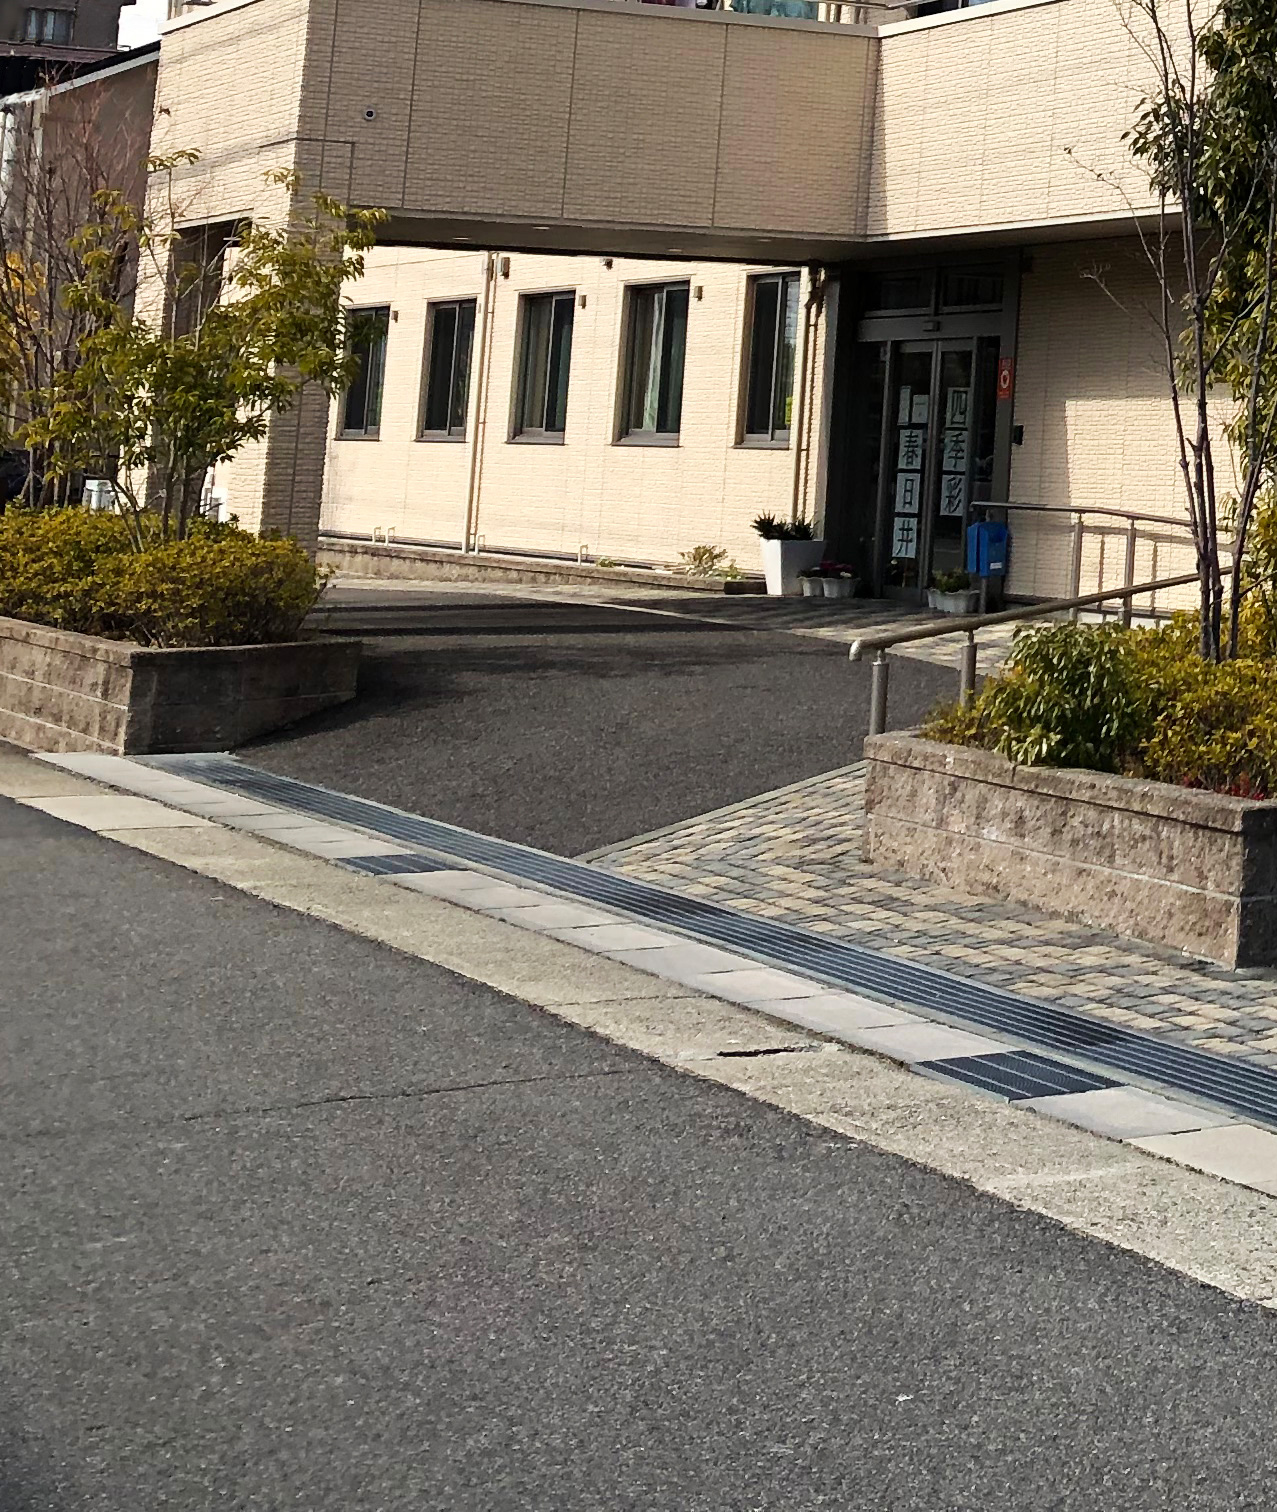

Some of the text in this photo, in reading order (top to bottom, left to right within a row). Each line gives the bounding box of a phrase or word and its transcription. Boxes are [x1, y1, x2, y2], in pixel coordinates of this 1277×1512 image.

[896, 431, 920, 556] 春日井
[944, 390, 968, 515] 四季彩
